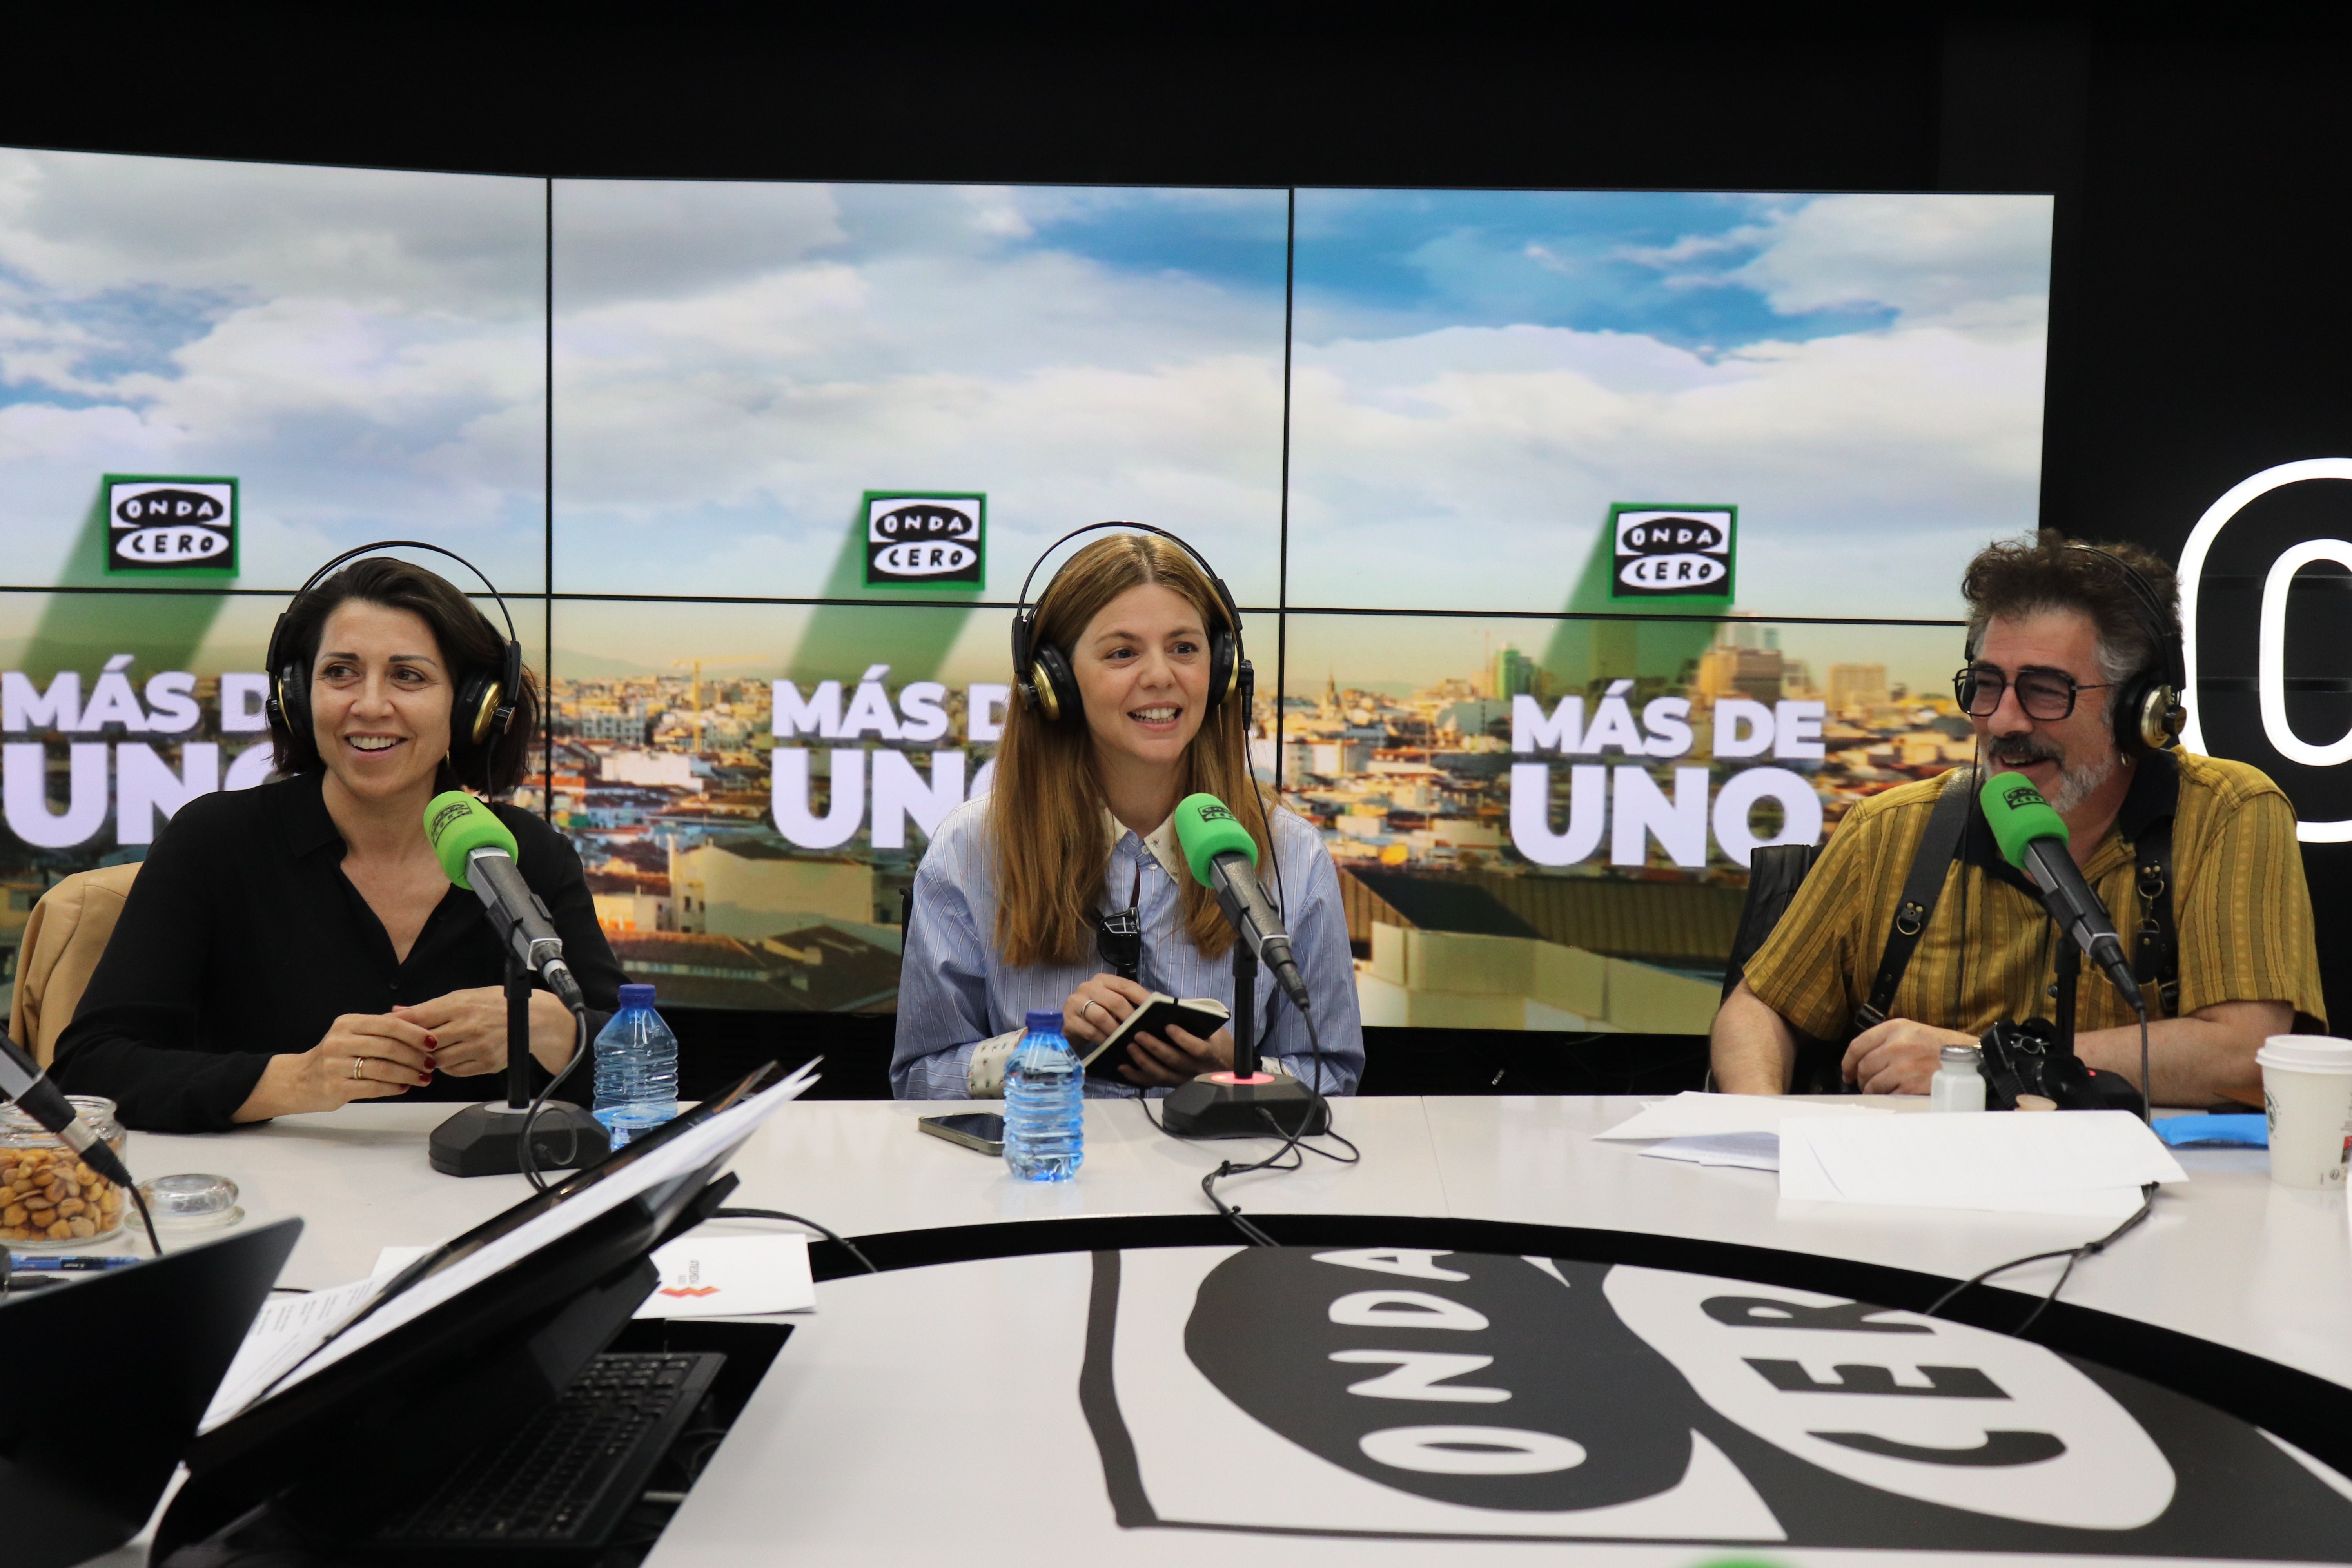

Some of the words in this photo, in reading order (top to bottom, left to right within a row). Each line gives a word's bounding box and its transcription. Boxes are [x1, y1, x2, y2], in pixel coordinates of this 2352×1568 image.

[126, 499, 214, 518] ONDA
[132, 534, 214, 553] CERO
[884, 514, 963, 533] ONDA
[1631, 528, 1713, 546] ONDA
[888, 548, 963, 567] CERO
[1635, 562, 1712, 580] CERO
[1, 654, 199, 733] MÁS
[221, 673, 270, 731] D
[771, 664, 949, 741] MÁS
[968, 683, 1011, 741] D
[1512, 679, 1694, 758] MÁS
[1713, 699, 1826, 759] DE
[771, 748, 997, 850] UN
[1510, 763, 1824, 868] UNO
[1310, 1247, 1587, 1475] ONDA
[1700, 1296, 2067, 1467] CER
